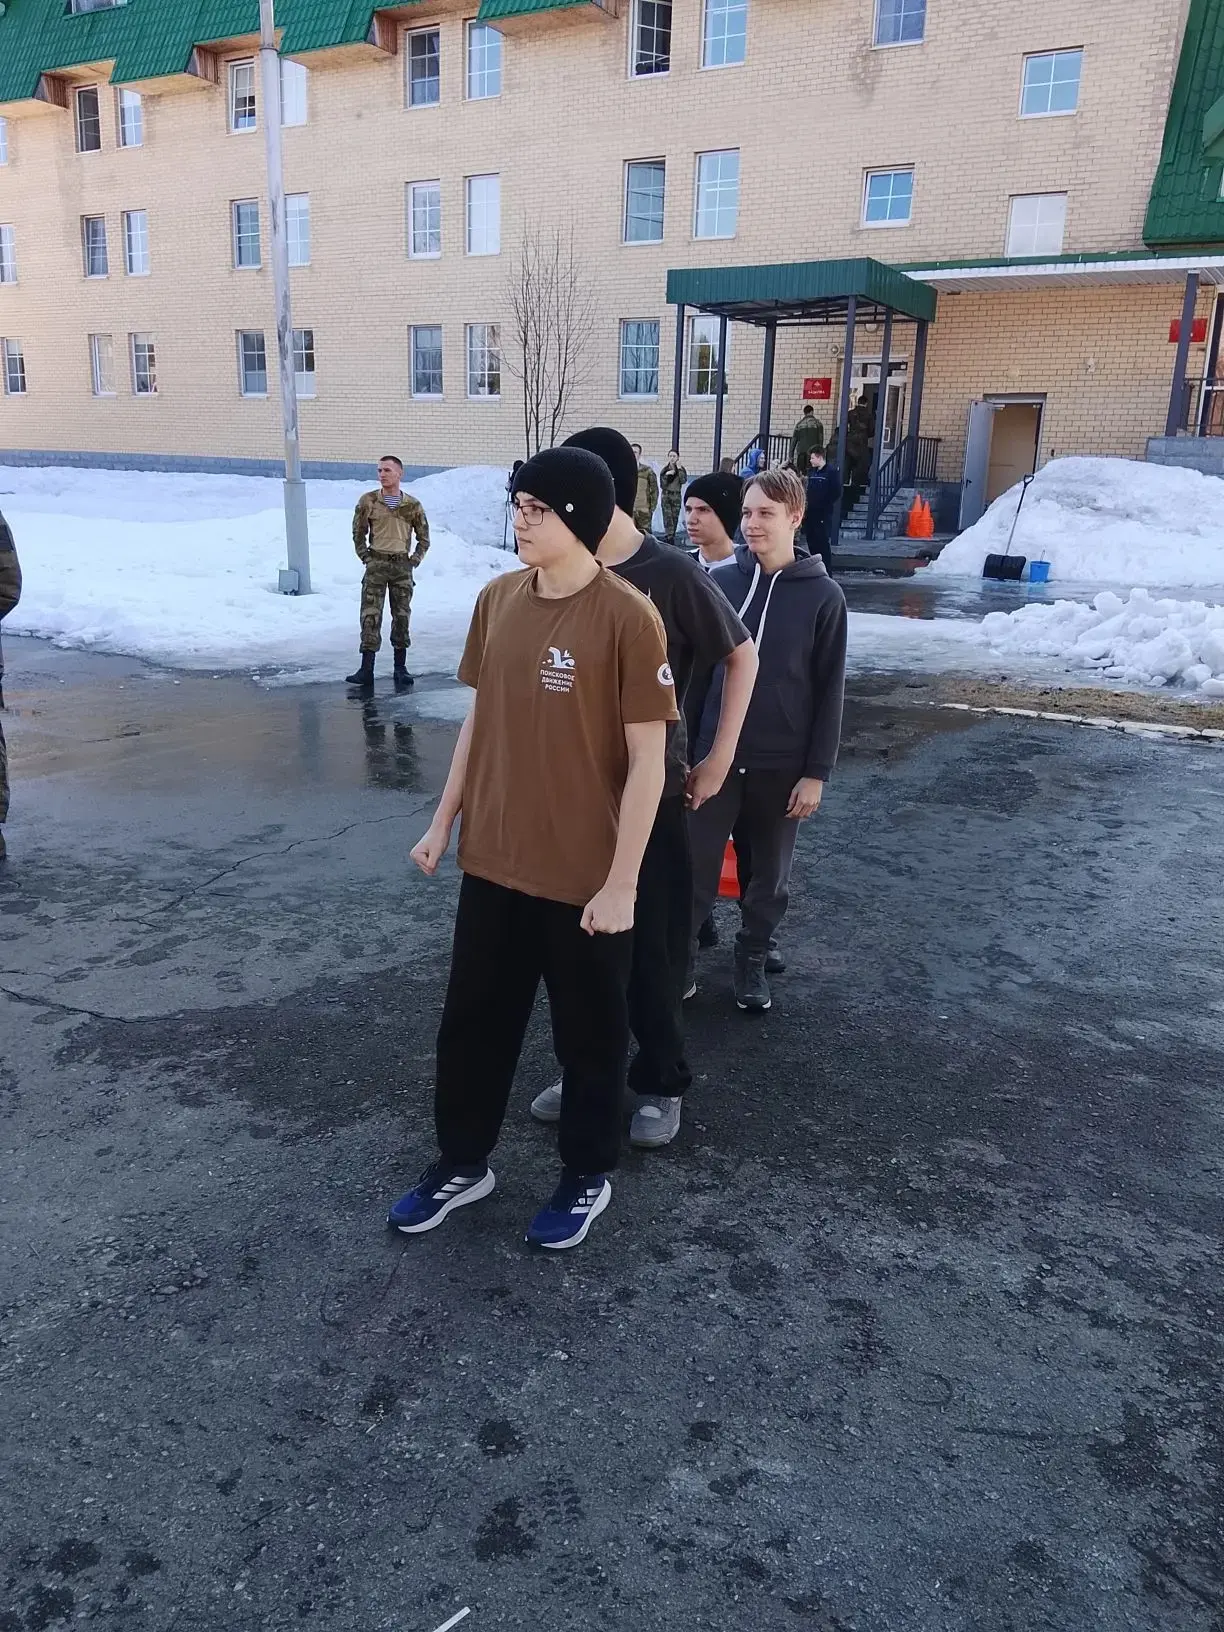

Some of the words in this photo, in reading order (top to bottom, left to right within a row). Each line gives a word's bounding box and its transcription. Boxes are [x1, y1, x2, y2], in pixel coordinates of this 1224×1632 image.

[540, 669, 575, 681] ПОИСКОВОЕ
[541, 676, 573, 687] ДВИЖЕНИЕ
[544, 684, 570, 693] РОССИИ
